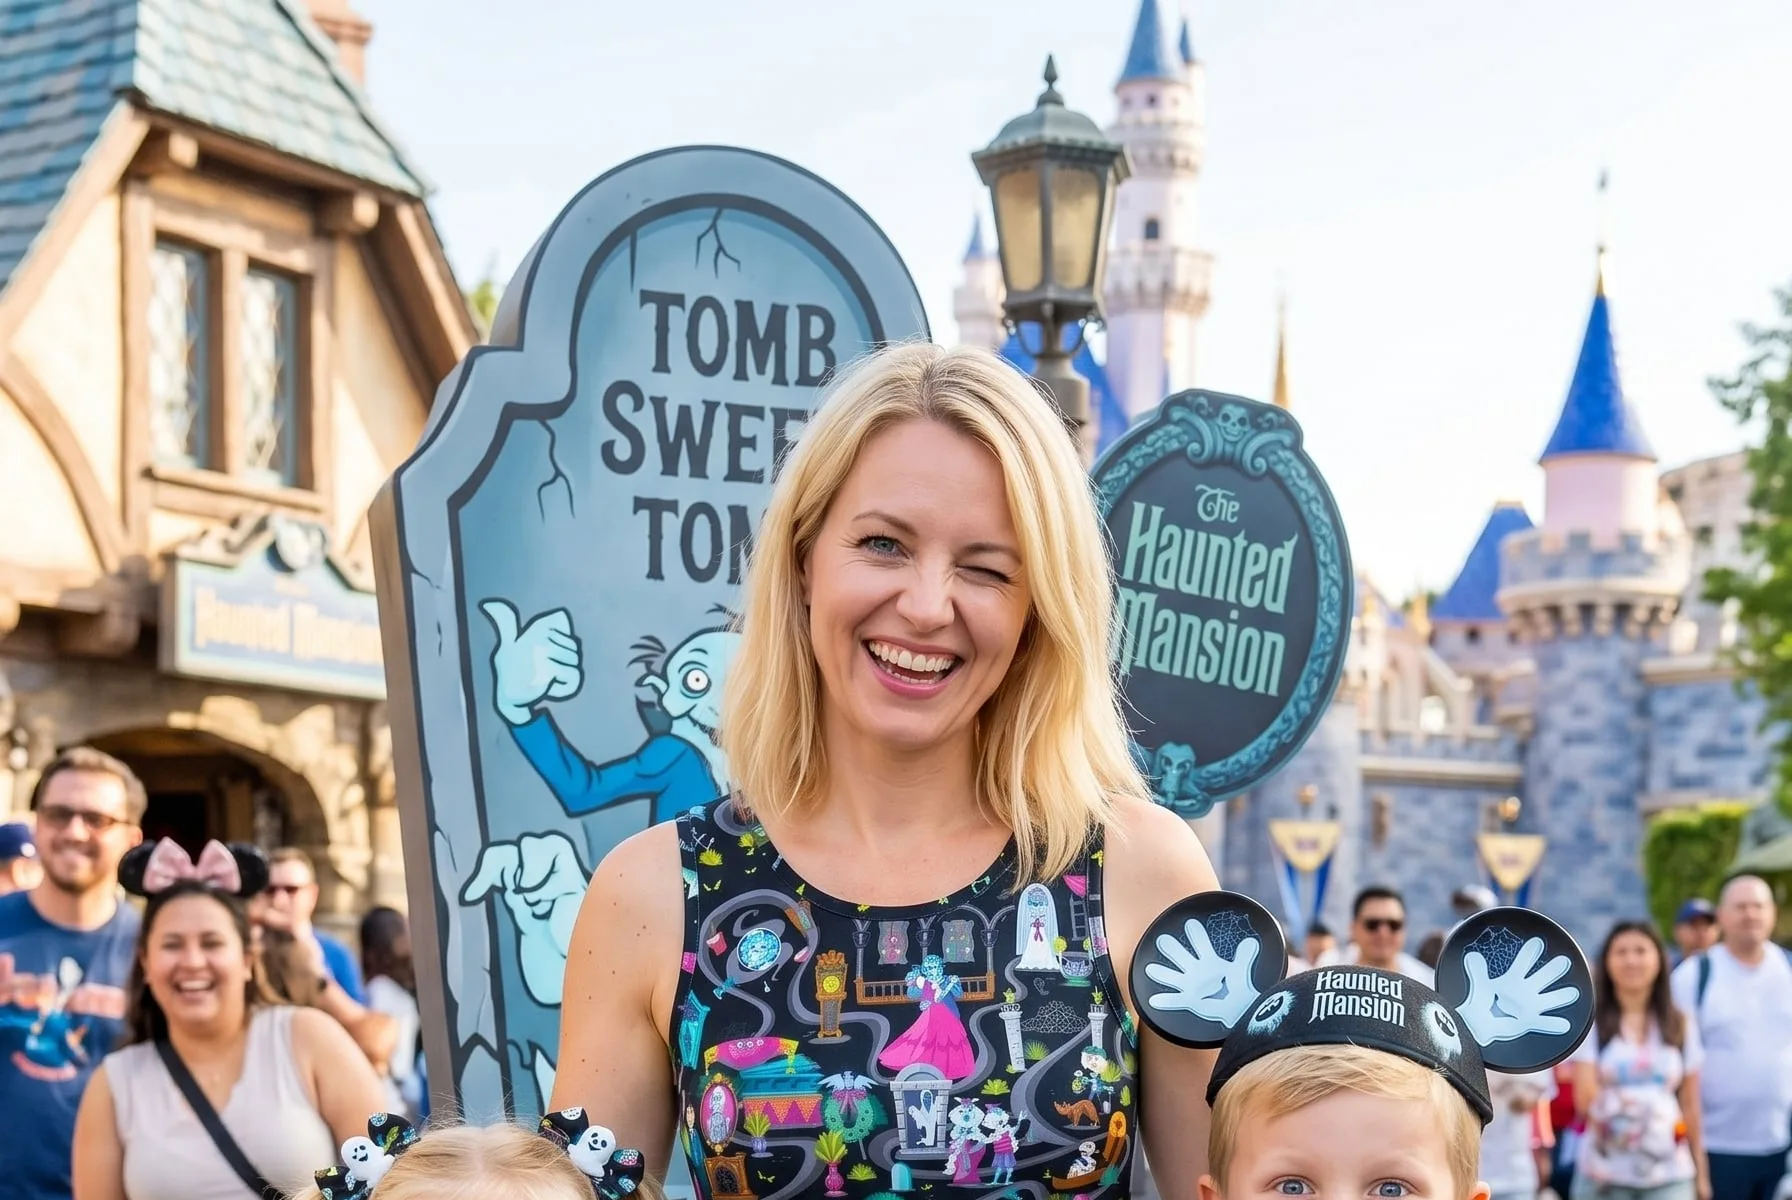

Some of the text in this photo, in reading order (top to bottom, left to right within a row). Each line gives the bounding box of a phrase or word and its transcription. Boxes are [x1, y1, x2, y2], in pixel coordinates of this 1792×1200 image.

[639, 288, 837, 388] TOMB
[600, 379, 818, 484] SWEE
[1195, 484, 1241, 524] The
[1121, 500, 1299, 615] Haunted
[1112, 586, 1286, 698] Mansion
[1307, 991, 1406, 1028] Mansion
